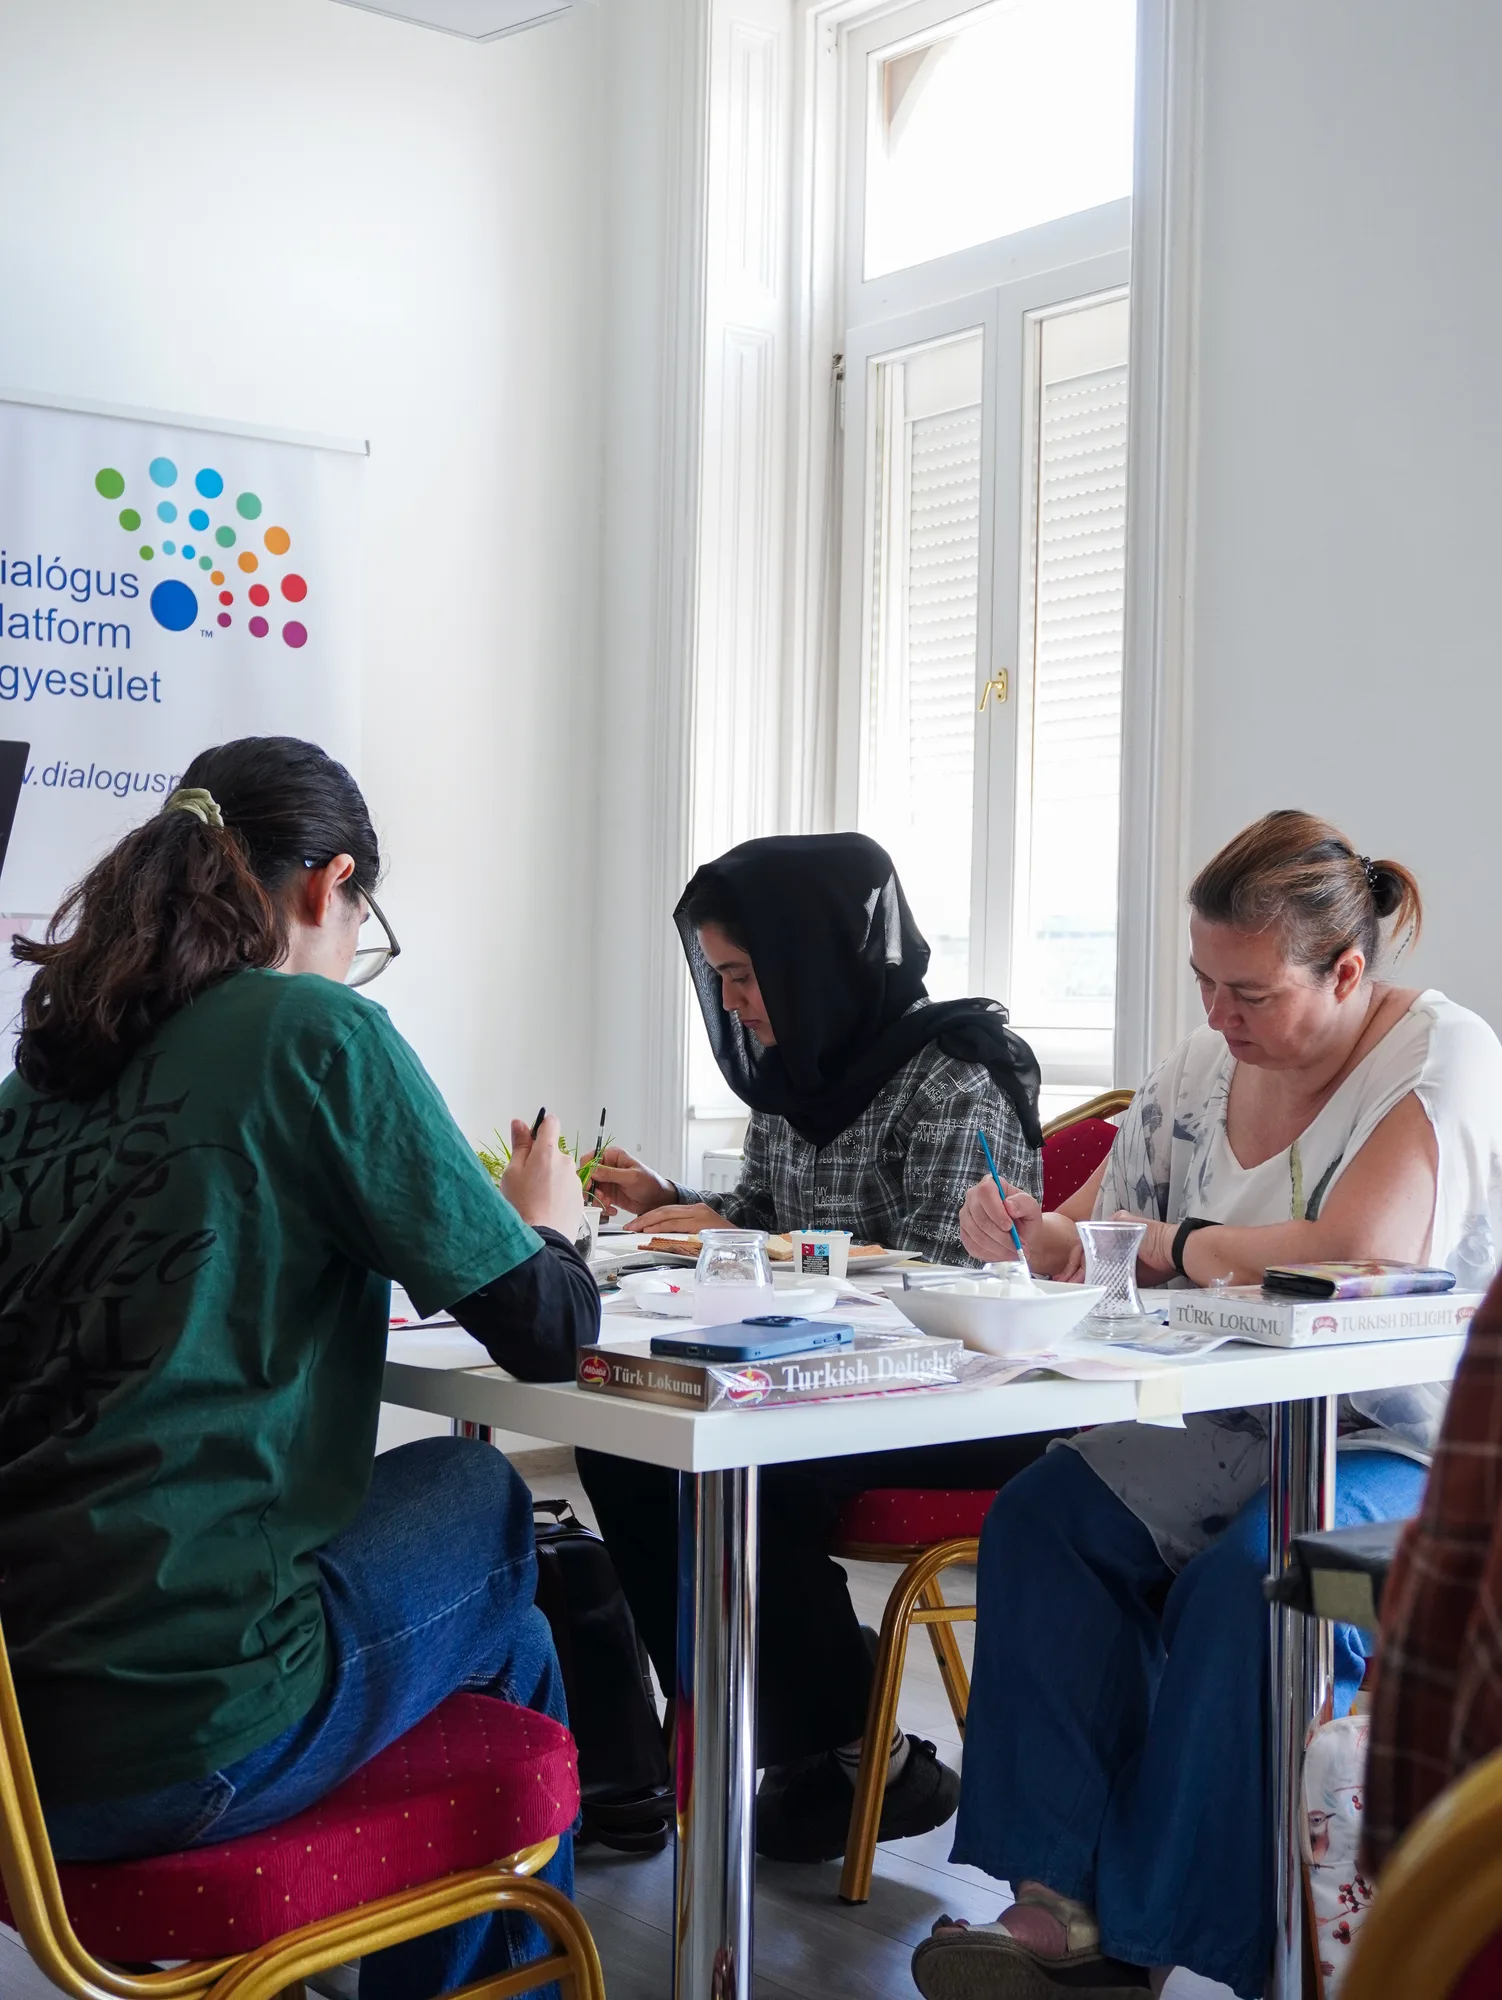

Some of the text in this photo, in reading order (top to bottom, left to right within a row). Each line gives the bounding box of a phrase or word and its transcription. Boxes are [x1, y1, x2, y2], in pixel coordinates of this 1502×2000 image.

[1176, 1304, 1214, 1326] TÜRK
[1219, 1312, 1284, 1336] LOKUMU
[1341, 1314, 1397, 1331] TURKISH
[1400, 1310, 1454, 1328] DELIGHT
[613, 1365, 702, 1396] Türk Lokumu
[782, 1358, 869, 1393] Turkish
[877, 1350, 954, 1384] Delight
